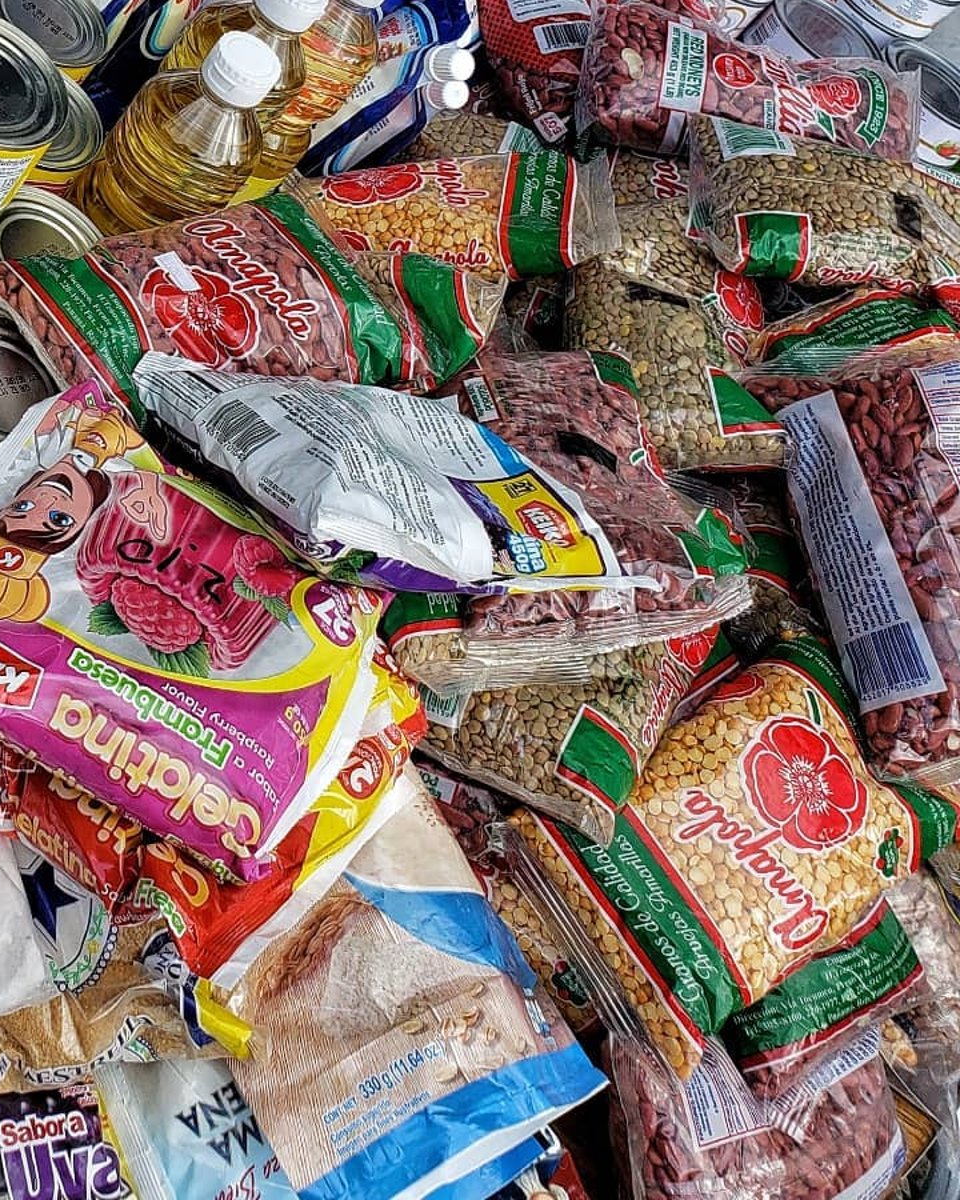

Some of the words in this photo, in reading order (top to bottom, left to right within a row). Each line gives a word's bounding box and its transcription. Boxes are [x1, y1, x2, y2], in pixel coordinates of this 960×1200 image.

[183, 218, 313, 342] Amapola
[69, 650, 234, 768] Frambuesa
[159, 676, 209, 719] Flavor
[206, 708, 279, 770] Raspberry
[51, 693, 262, 858] Gelatina
[584, 840, 641, 919] Calidad
[611, 831, 675, 919] Amarillas
[674, 790, 829, 954] Amapola
[628, 906, 661, 940] de
[659, 911, 720, 982] Arvejas
[652, 936, 708, 1006] Granos
[358, 1076, 382, 1099] 330
[391, 1048, 426, 1084] (11,64
[1, 1117, 65, 1146] Sabor
[70, 1115, 85, 1134] a
[2, 1142, 122, 1200] Uva
